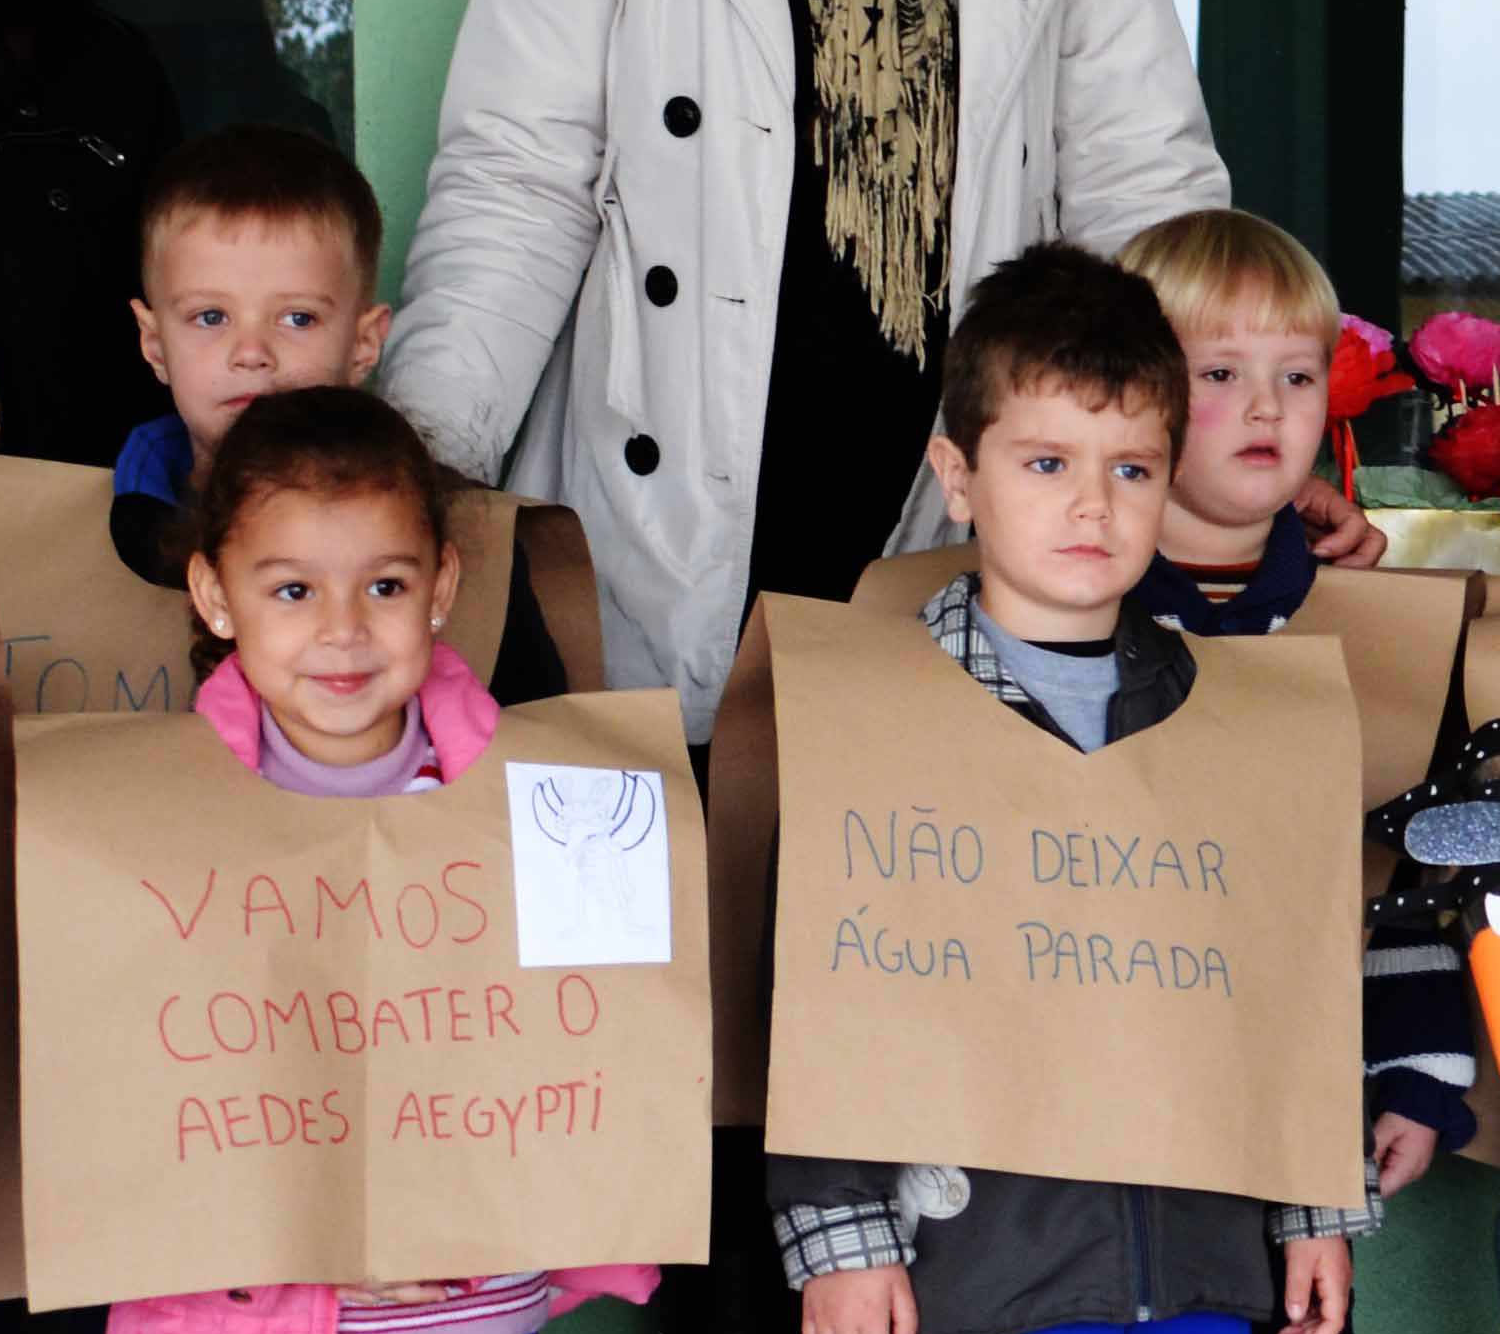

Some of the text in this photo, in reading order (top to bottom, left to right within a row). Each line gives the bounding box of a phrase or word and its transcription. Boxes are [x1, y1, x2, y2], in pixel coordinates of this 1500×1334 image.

[3, 634, 198, 713] TOM
[842, 803, 1229, 898] NÃO DEIXAR
[140, 860, 490, 951] VAMOS
[830, 903, 1235, 999] ÁGUA PARADA
[157, 973, 601, 1063] COMBATER O
[176, 1071, 605, 1164] AEDES AEGYPTI
